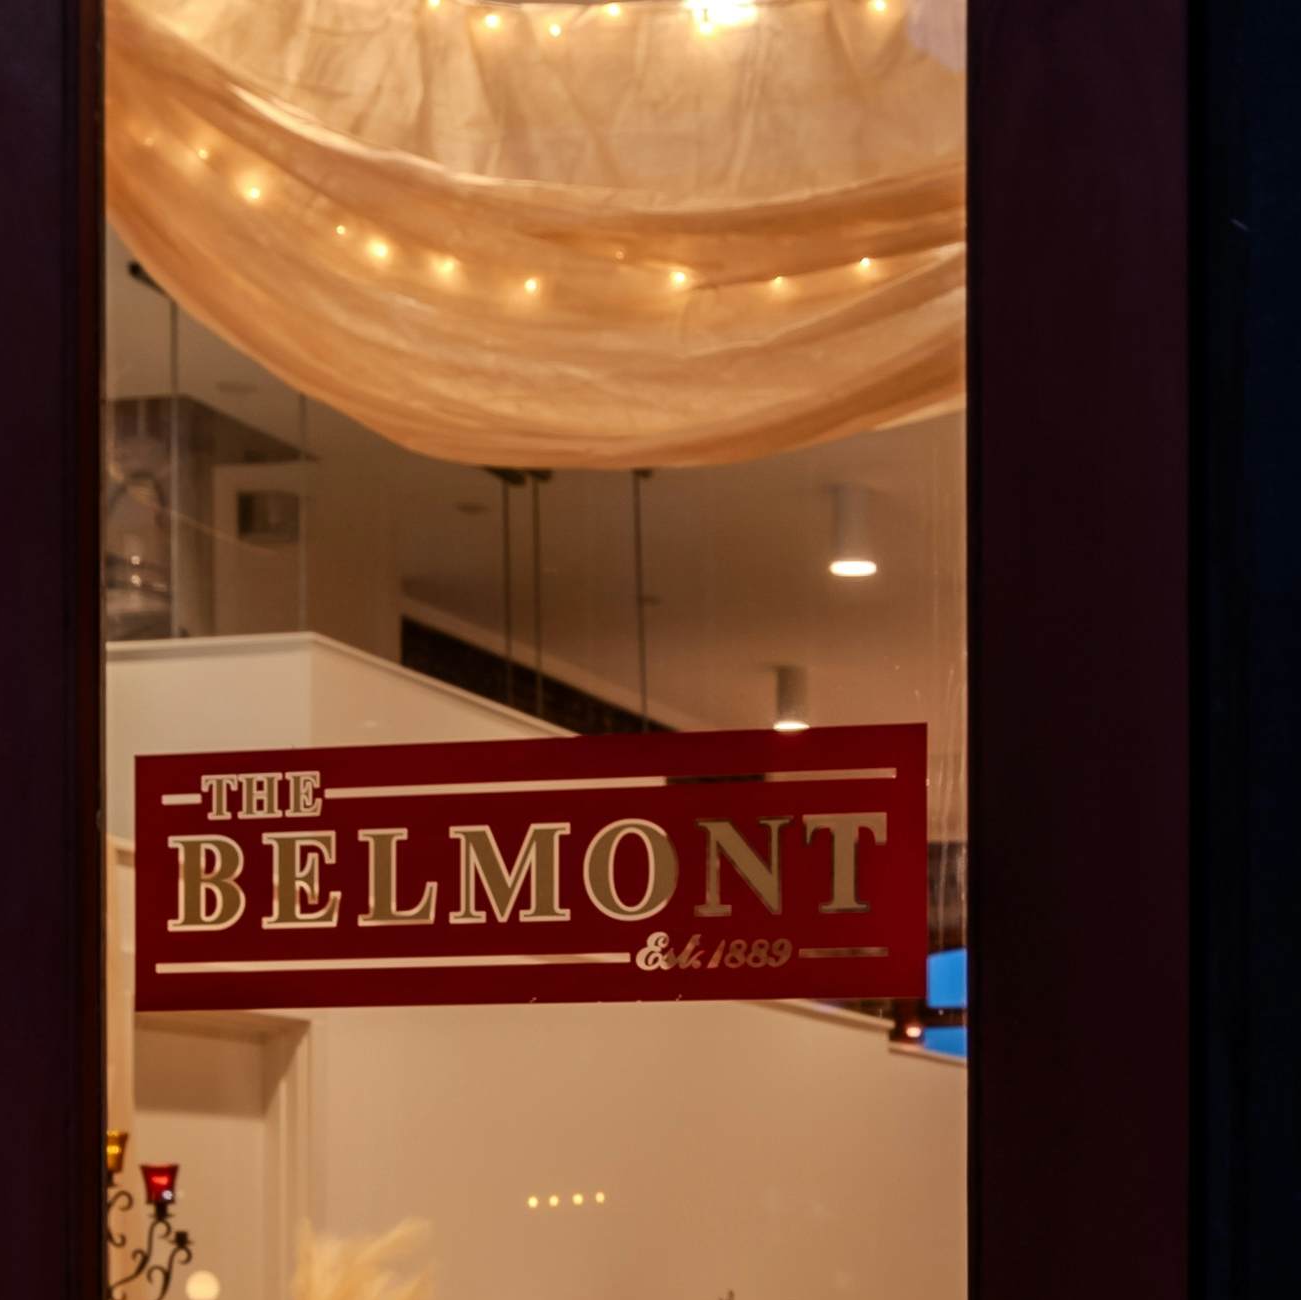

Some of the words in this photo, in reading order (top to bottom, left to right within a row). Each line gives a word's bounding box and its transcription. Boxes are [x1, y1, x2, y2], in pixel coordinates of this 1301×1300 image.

[200, 770, 323, 821] THE
[166, 811, 888, 933] BELMONT
[706, 938, 793, 969] 1889
